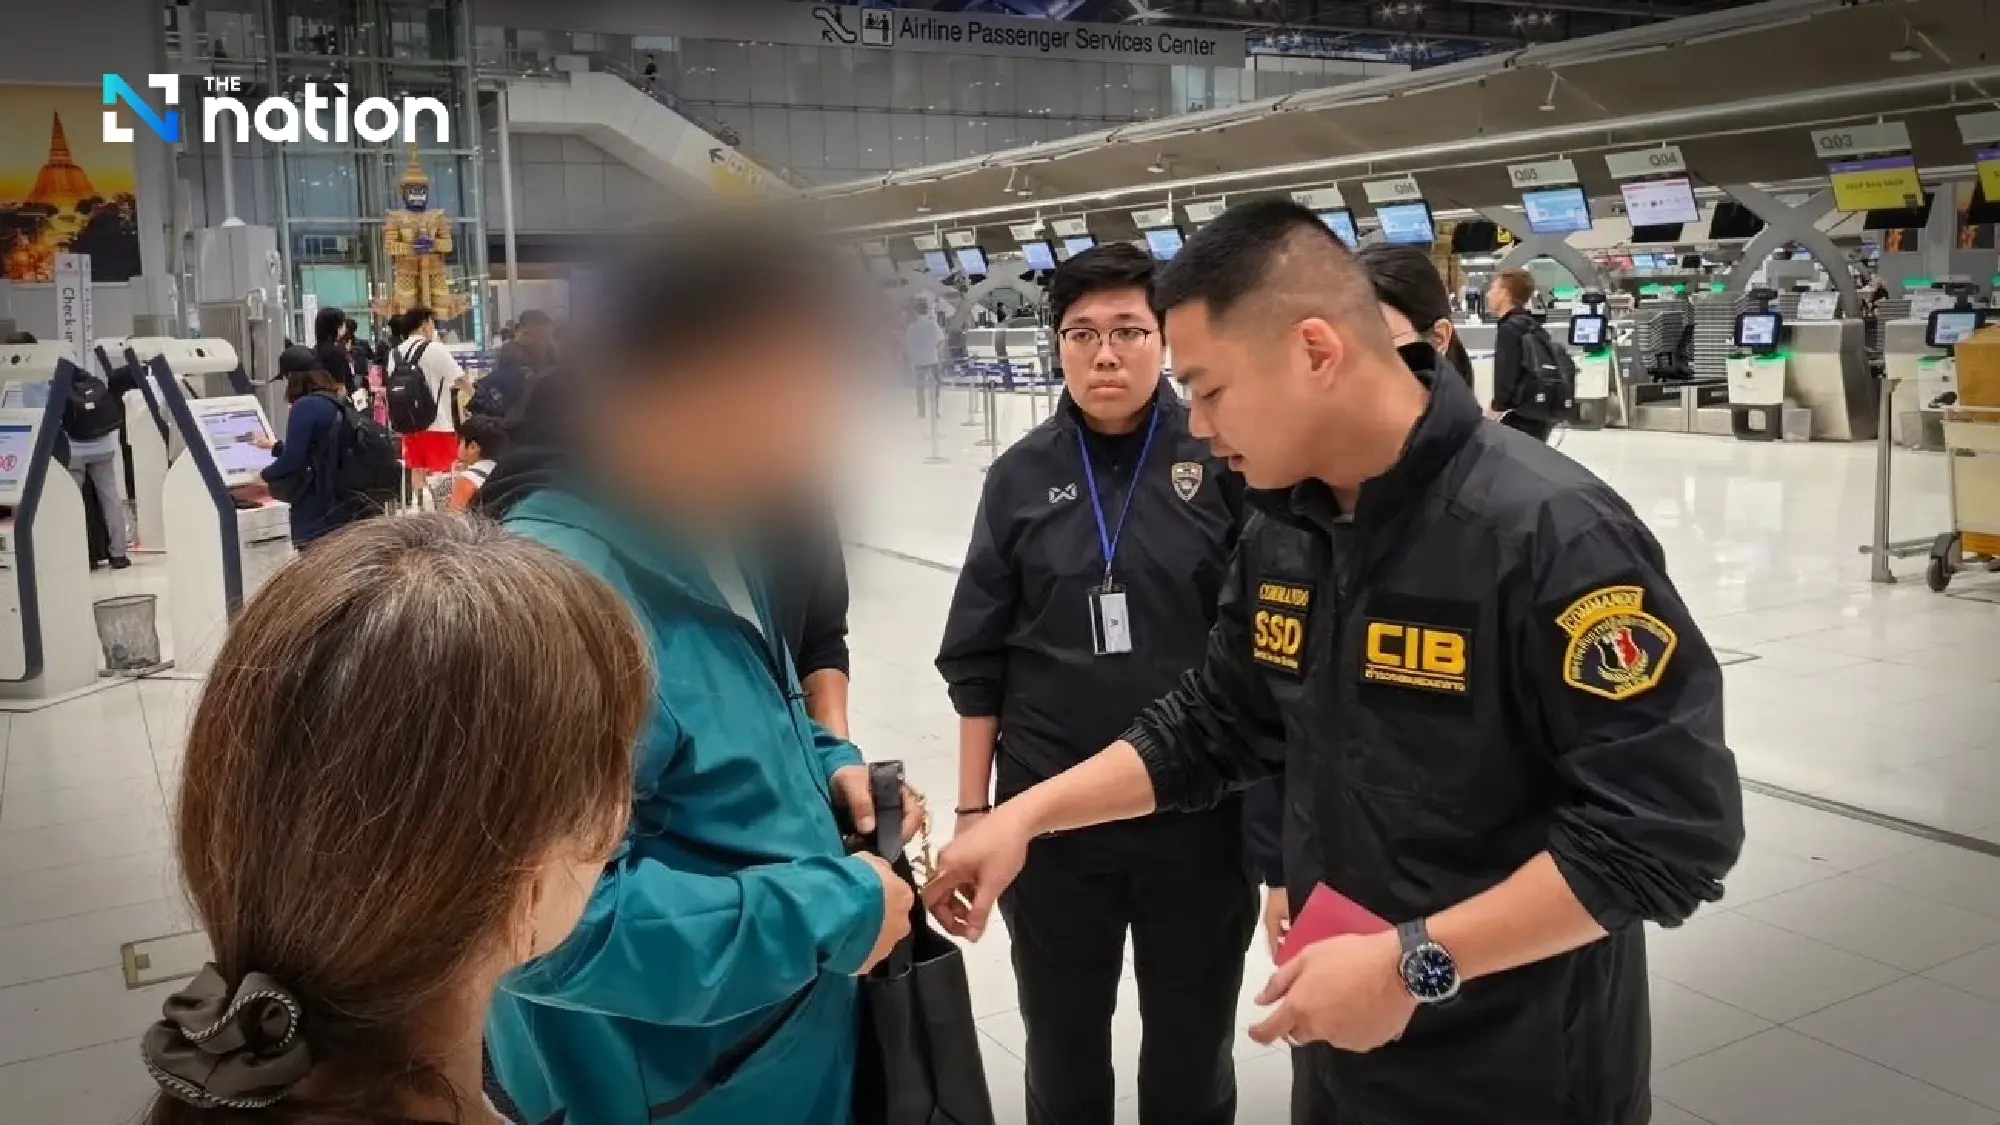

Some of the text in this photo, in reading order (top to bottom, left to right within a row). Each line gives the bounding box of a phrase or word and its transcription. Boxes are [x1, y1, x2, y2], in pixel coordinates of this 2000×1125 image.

[900, 16, 1217, 55] Airline Passenger Services Center
[1649, 152, 1678, 167] Q04
[1820, 134, 1853, 150] Q03
[1254, 610, 1302, 656] SSD
[1367, 622, 1467, 675] CIB
